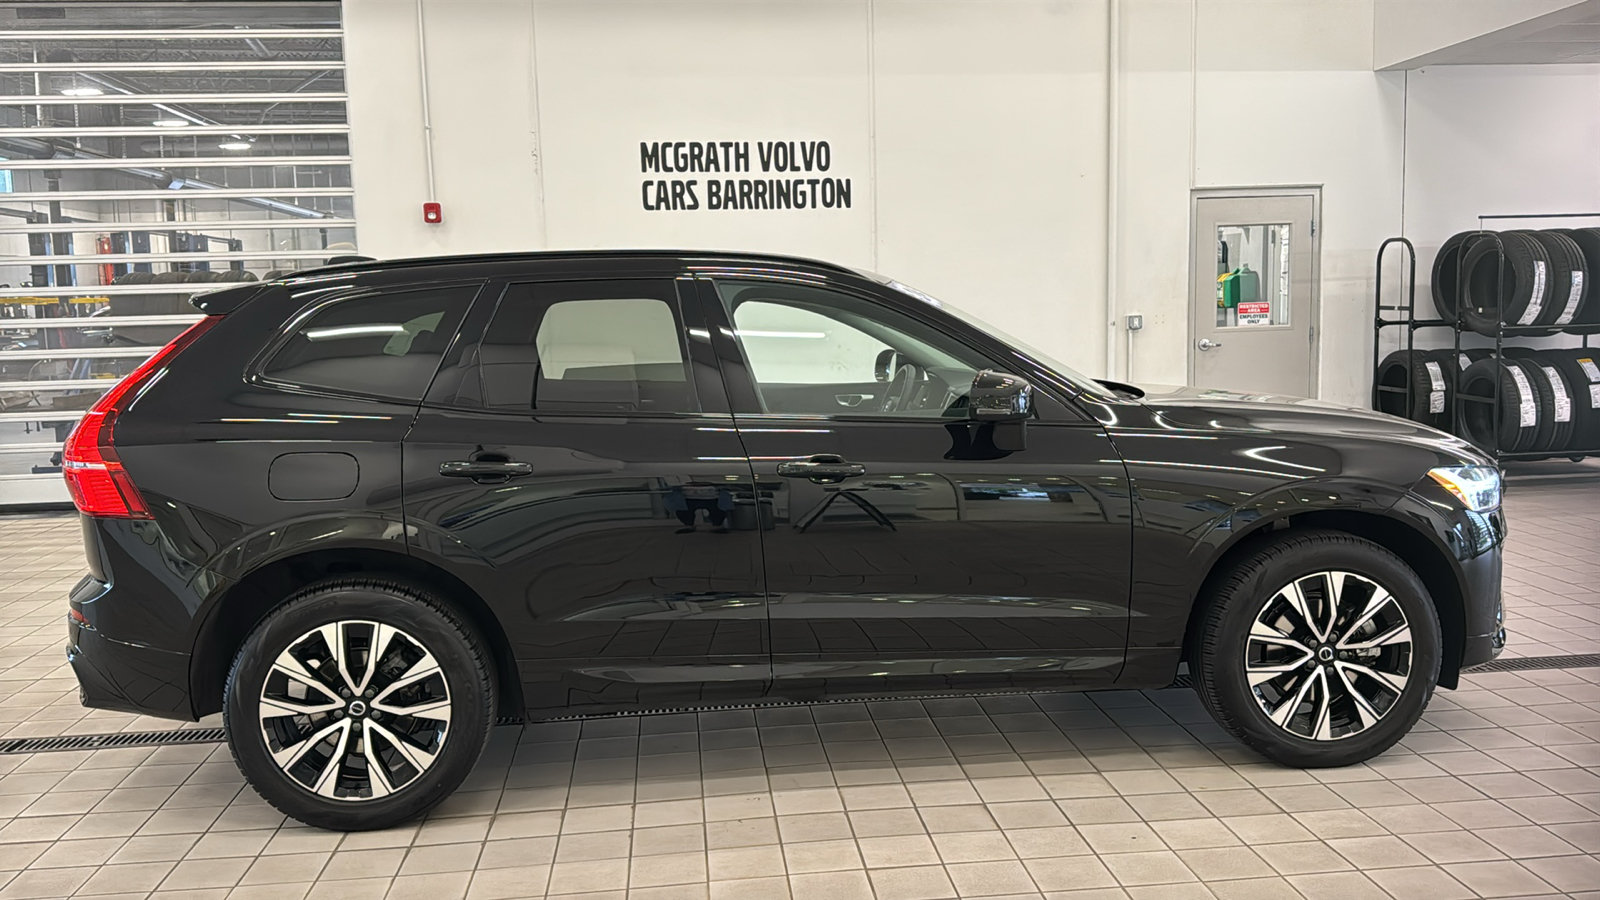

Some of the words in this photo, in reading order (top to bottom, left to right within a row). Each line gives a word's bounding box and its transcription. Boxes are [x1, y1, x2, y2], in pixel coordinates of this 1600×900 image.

[640, 142, 749, 172] MCGRATH
[757, 141, 830, 172] VOLVO
[642, 180, 699, 210] CARS
[707, 178, 851, 209] BARRINGTON
